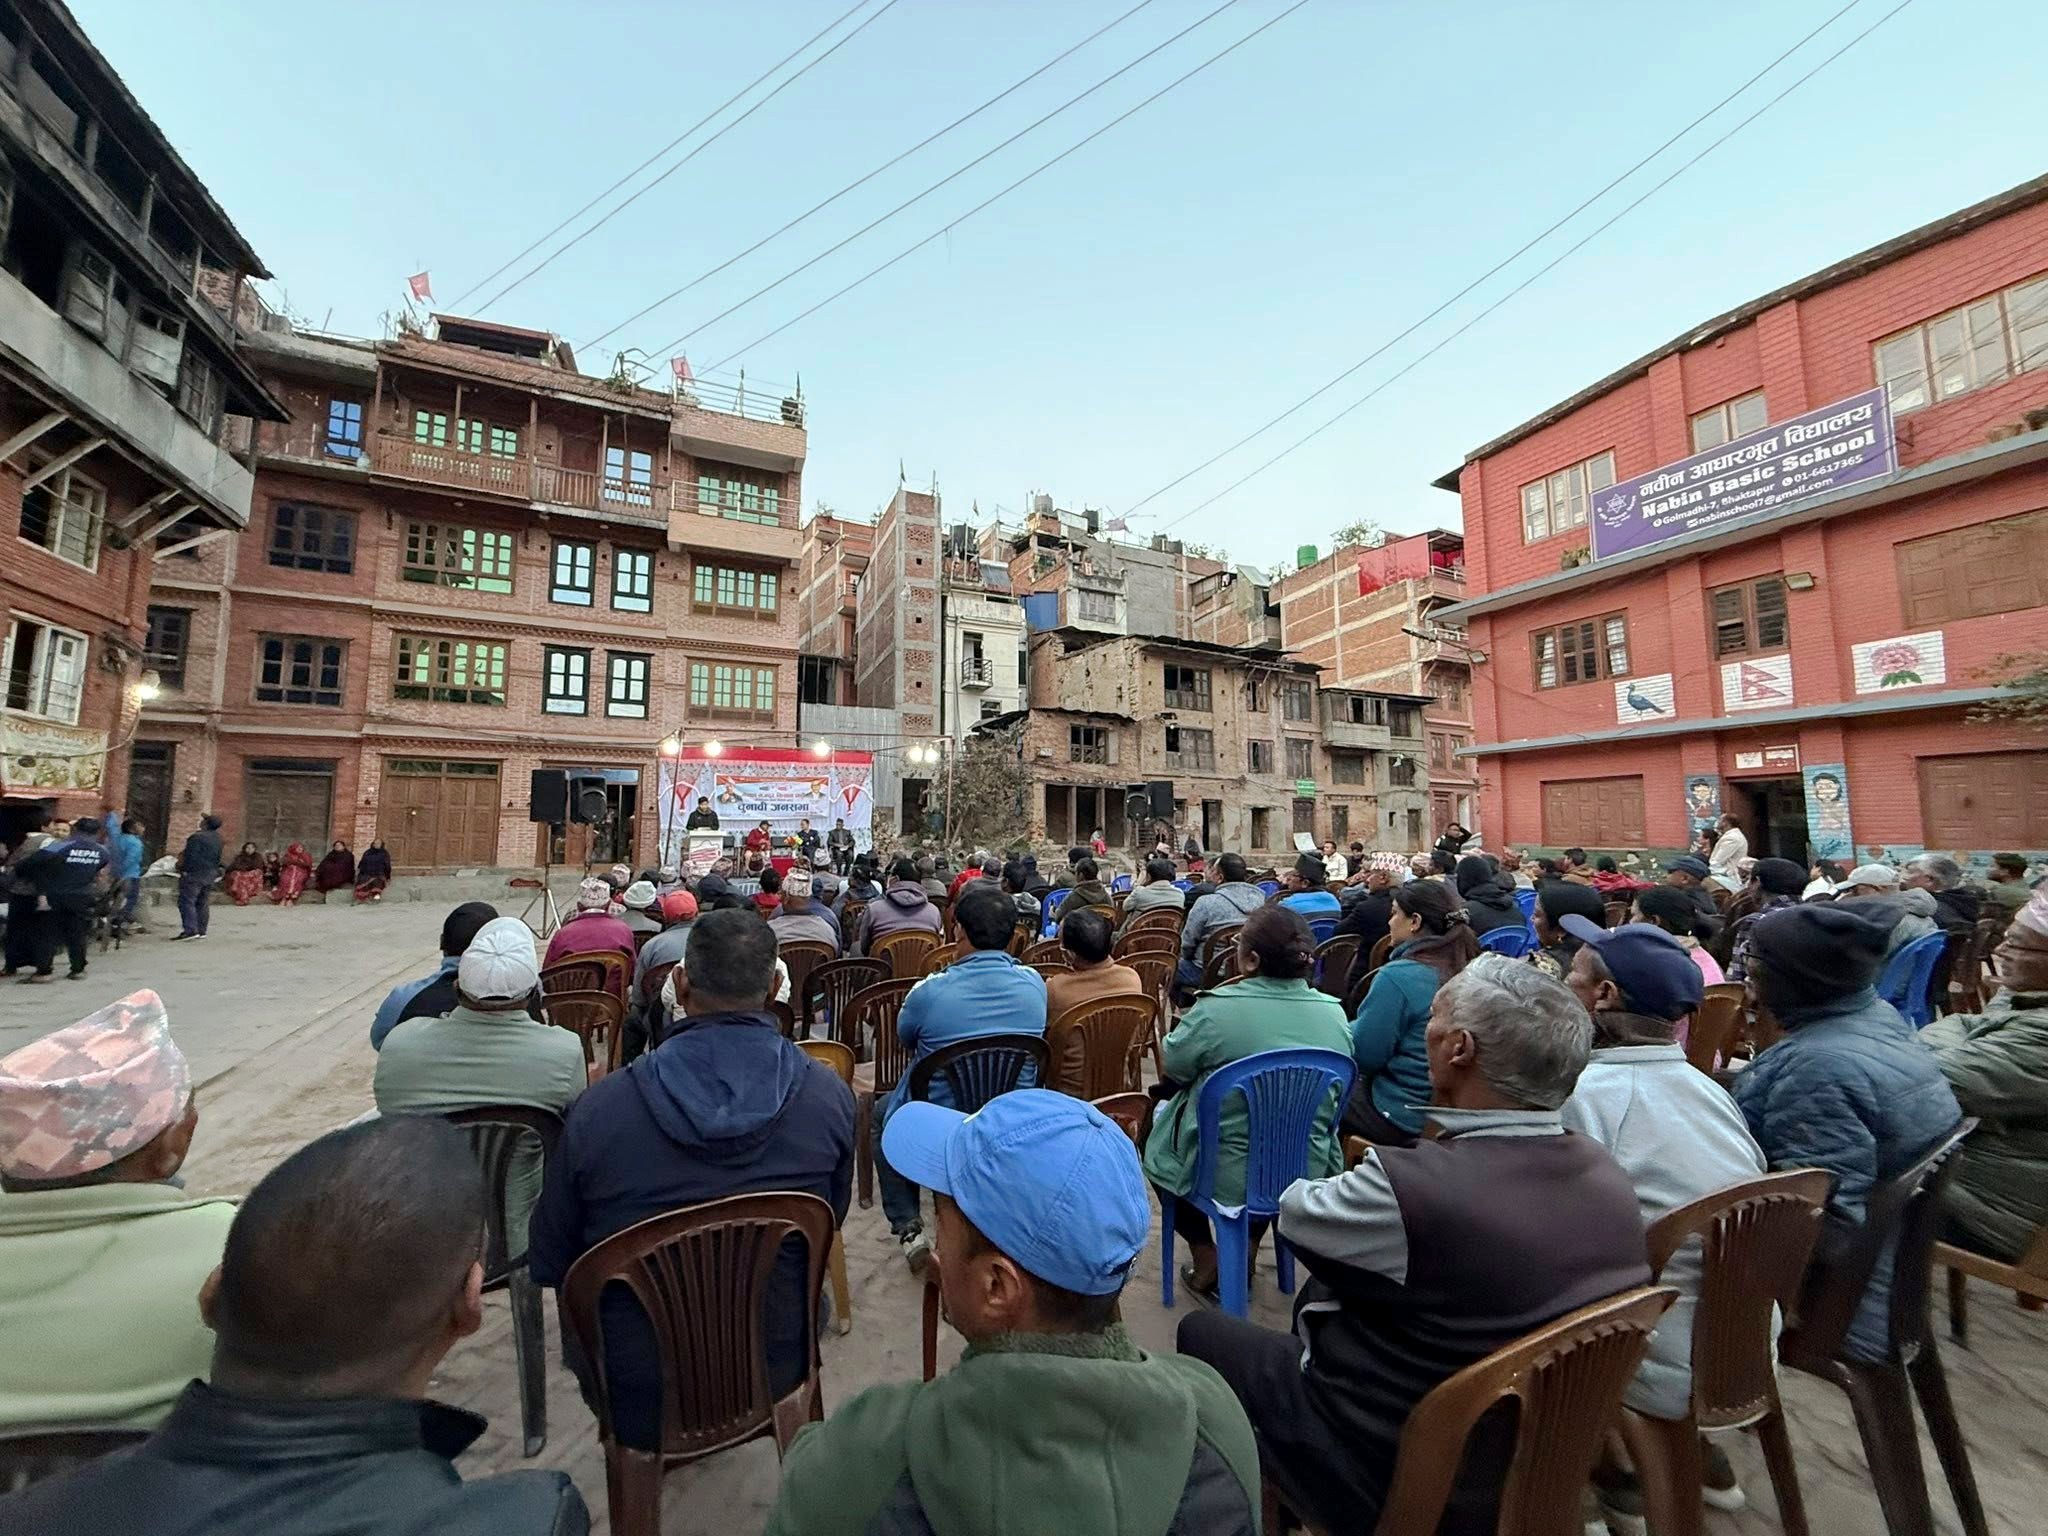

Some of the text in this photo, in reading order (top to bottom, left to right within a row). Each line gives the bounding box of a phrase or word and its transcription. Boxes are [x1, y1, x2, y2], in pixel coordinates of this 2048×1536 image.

[1639, 403, 1873, 496] नवीन आधारभूत विद्यालय
[1641, 490, 1703, 519] Nabin
[1708, 466, 1776, 496] Basic
[1781, 429, 1876, 472] School
[1699, 477, 1834, 525] nabinschool7@gmail.com
[1721, 482, 1776, 505] Bhaktapur
[1794, 454, 1863, 483] 01-6617365
[738, 801, 809, 813] चुनावी जनसभा
[69, 849, 101, 858] NEPAL
